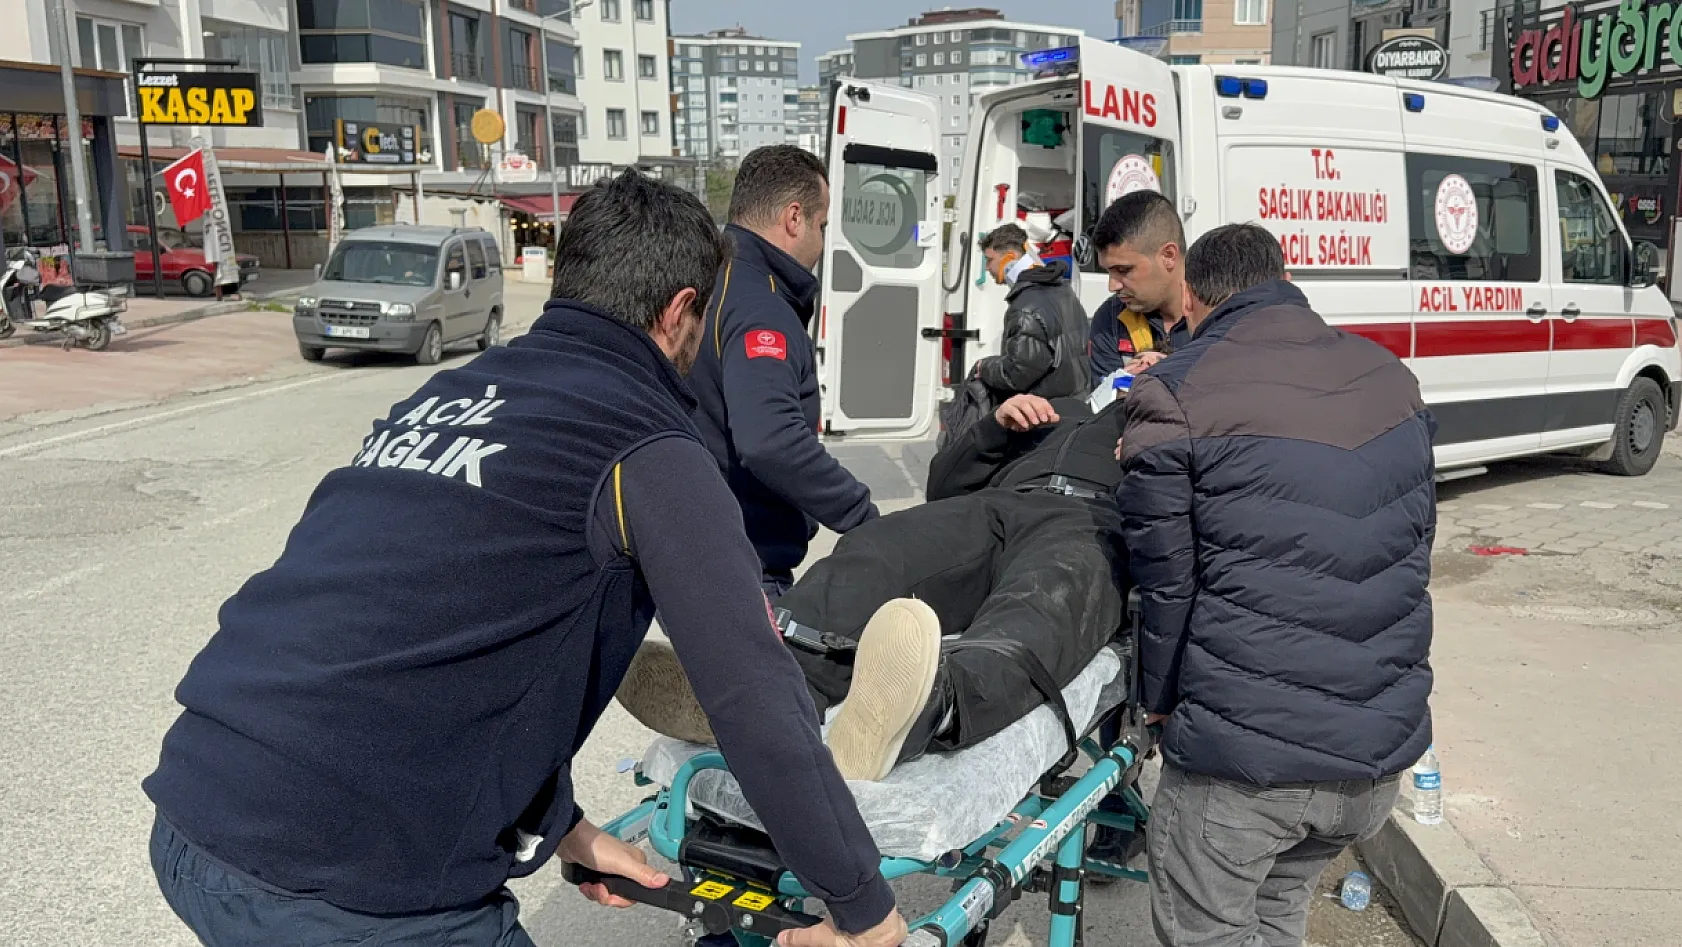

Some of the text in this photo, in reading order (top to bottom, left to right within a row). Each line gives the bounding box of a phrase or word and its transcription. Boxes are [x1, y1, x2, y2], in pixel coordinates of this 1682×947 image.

[138, 73, 179, 86] Lezzet
[139, 87, 254, 124] KASAP
[1084, 80, 1157, 128] LANS
[1311, 149, 1341, 180] T.C.
[1259, 183, 1388, 223] SAĞLIK BAKANLIĞI
[1281, 228, 1372, 265] ACİL SAĞLIK
[1461, 287, 1522, 311] YARDIM
[395, 385, 506, 425] ACİL
